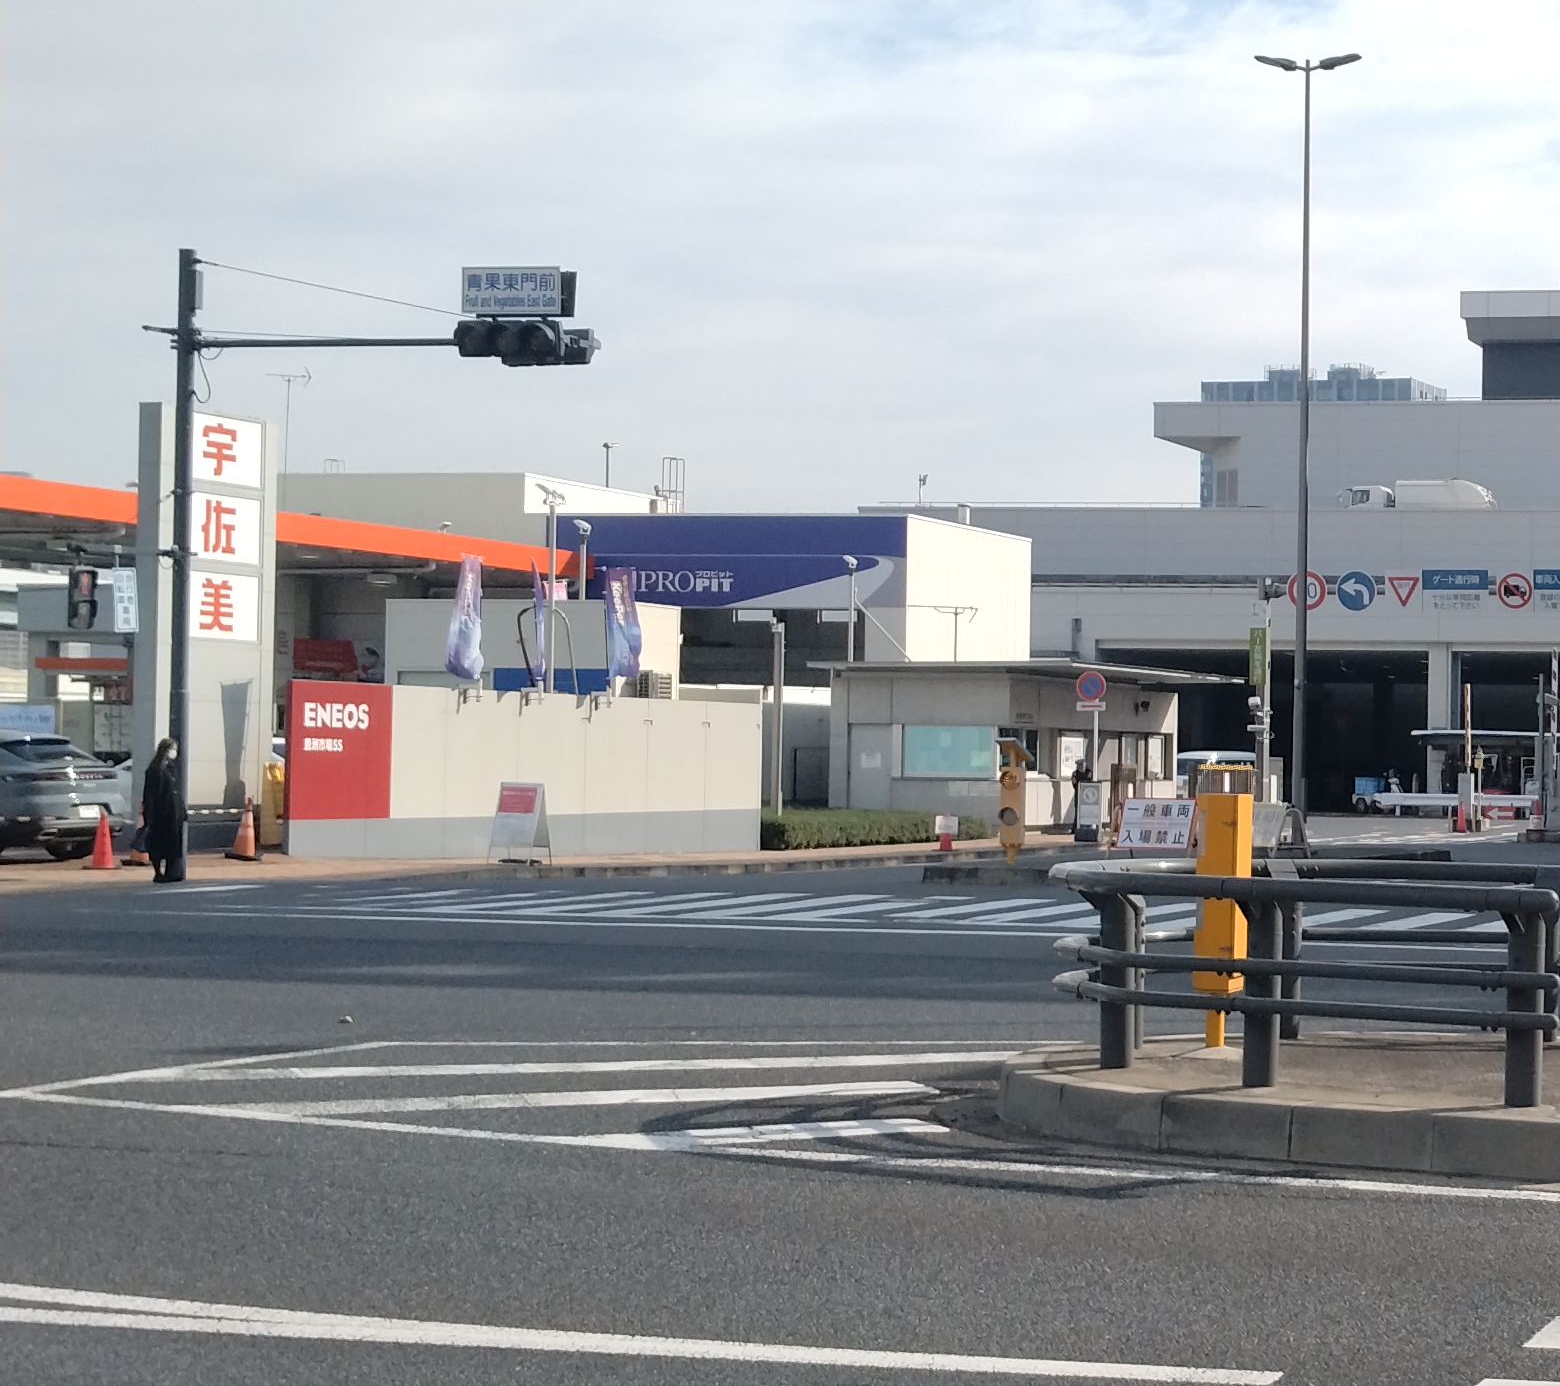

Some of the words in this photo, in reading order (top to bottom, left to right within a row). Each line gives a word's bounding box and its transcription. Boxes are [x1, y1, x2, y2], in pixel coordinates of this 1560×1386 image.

[466, 273, 557, 292] 青果東門前
[199, 422, 238, 632] 宇佐美
[1432, 574, 1480, 585] ゲート通行時
[303, 702, 369, 730] ENEOS
[1127, 803, 1191, 818] 一般車両
[1121, 829, 1185, 844] 入場禁止
